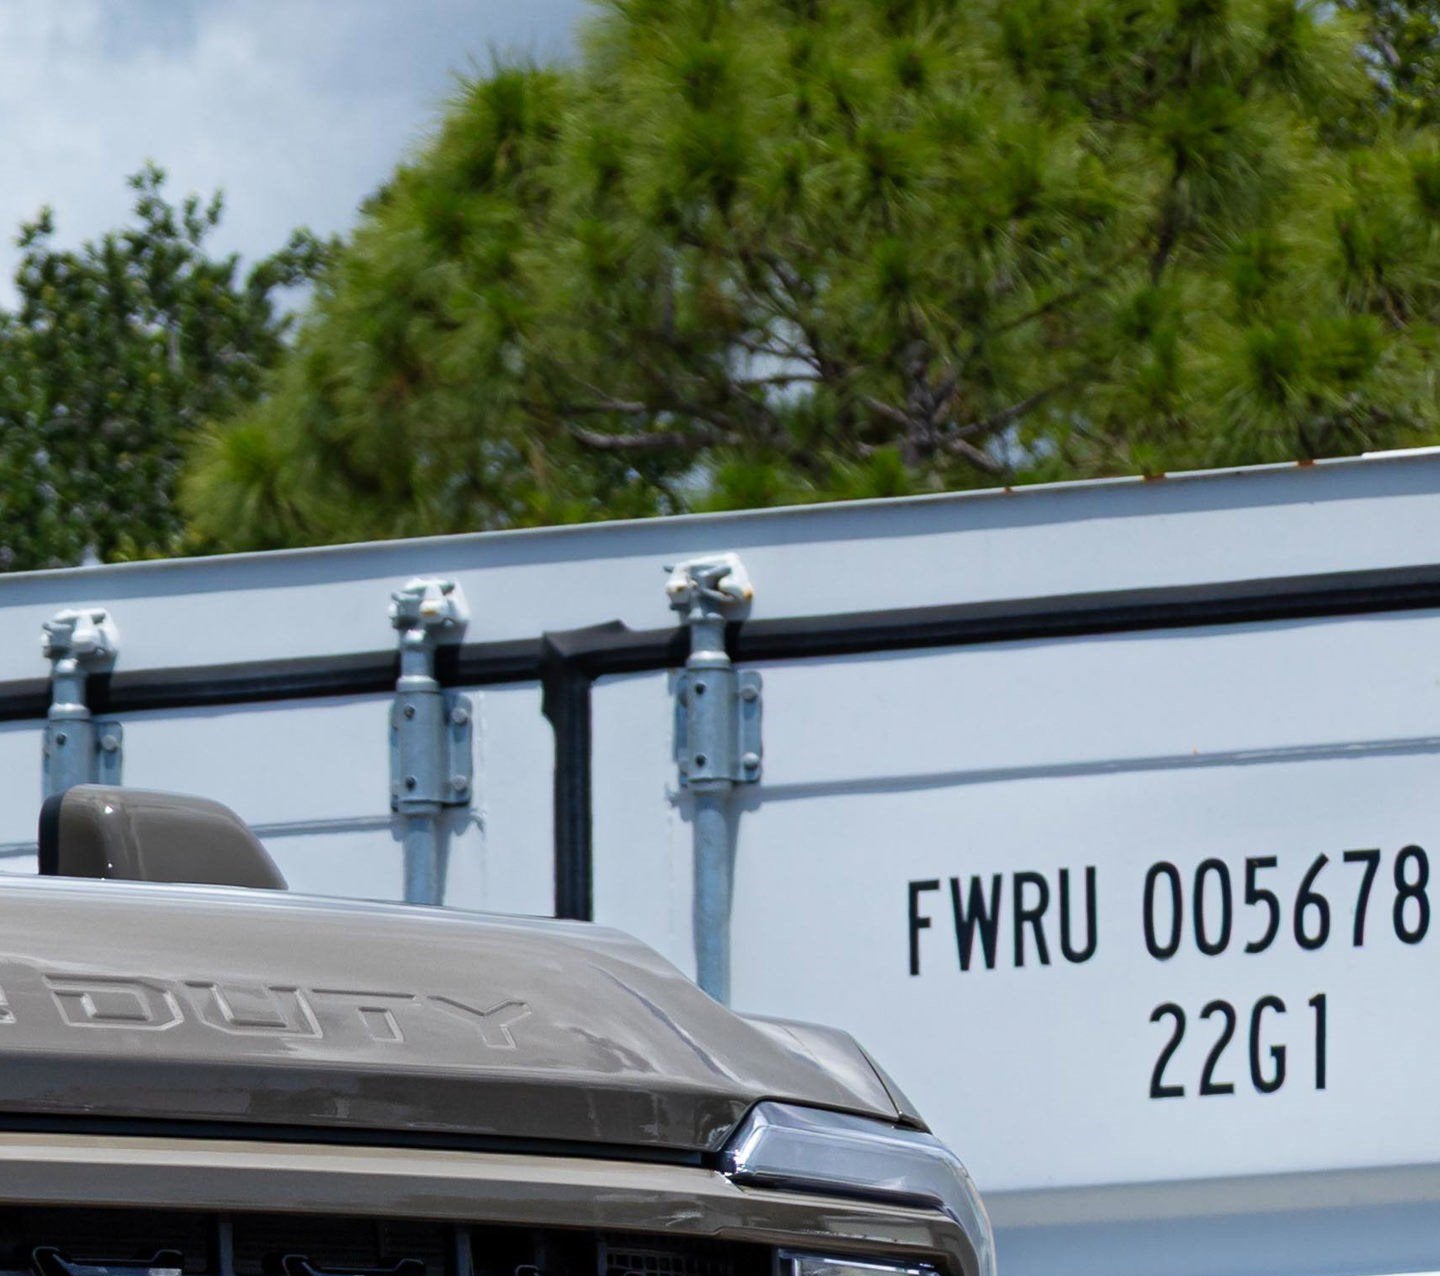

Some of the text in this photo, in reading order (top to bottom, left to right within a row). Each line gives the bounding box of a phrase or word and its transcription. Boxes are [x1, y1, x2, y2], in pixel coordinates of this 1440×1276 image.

[908, 844, 1431, 977] FWRU 005678
[40, 972, 530, 1053] DUTY
[1149, 993, 1327, 1100] 22G1
